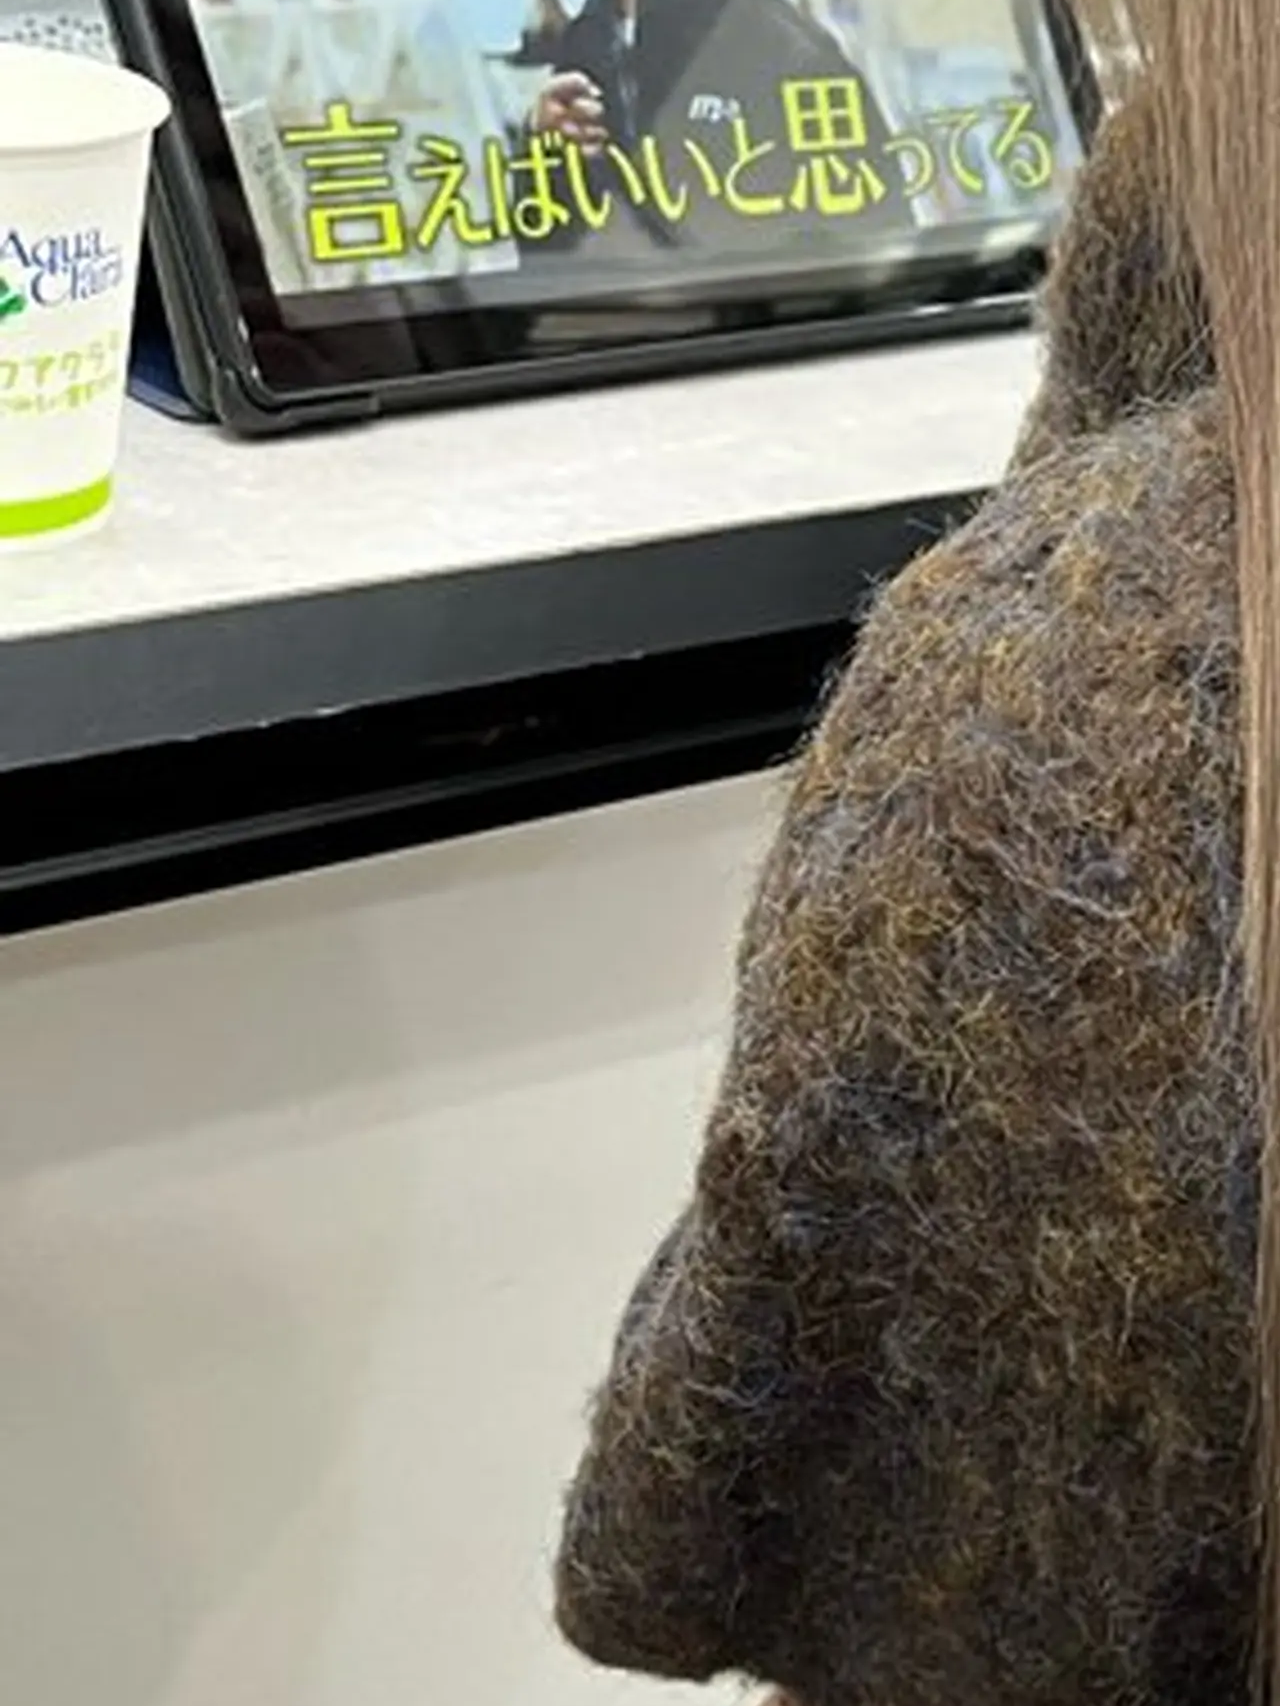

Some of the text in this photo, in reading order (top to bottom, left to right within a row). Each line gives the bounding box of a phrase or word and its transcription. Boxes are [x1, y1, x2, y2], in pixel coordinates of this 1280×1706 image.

[283, 76, 1051, 260] 言えばいいと思ってる
[0, 229, 105, 275] Aqua
